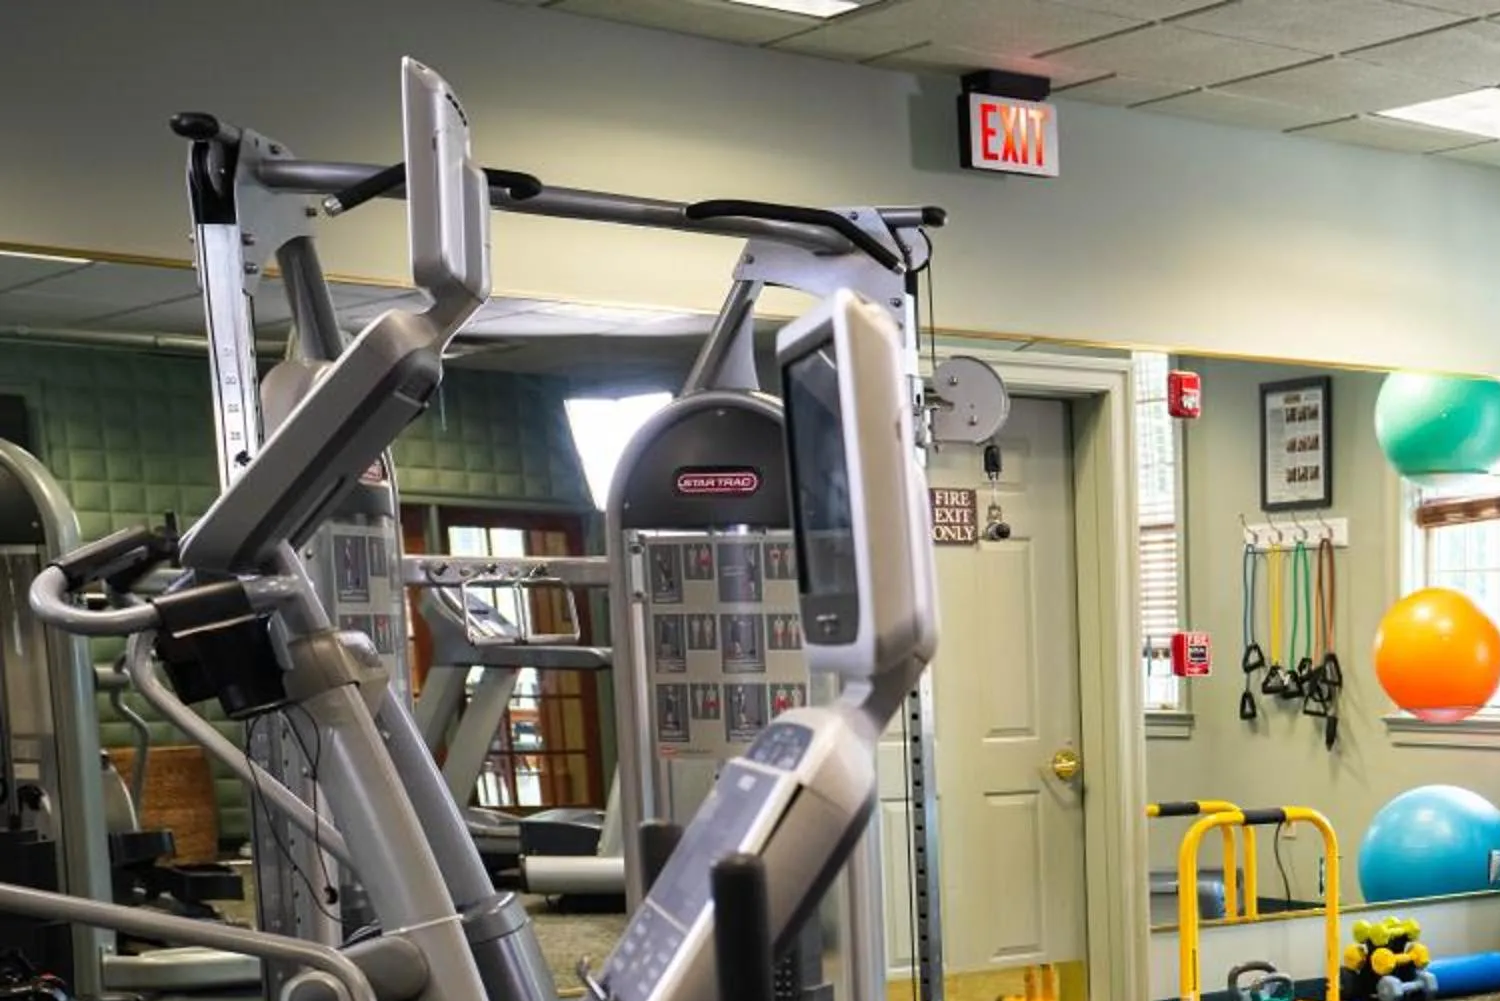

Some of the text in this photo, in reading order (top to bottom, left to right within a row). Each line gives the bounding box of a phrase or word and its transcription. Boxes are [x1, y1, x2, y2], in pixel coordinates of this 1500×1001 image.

[979, 102, 1046, 167] EXIT
[683, 478, 715, 487] STAR
[934, 490, 971, 506] FIRE
[934, 507, 972, 523] EXIT
[931, 525, 975, 541] ONLY
